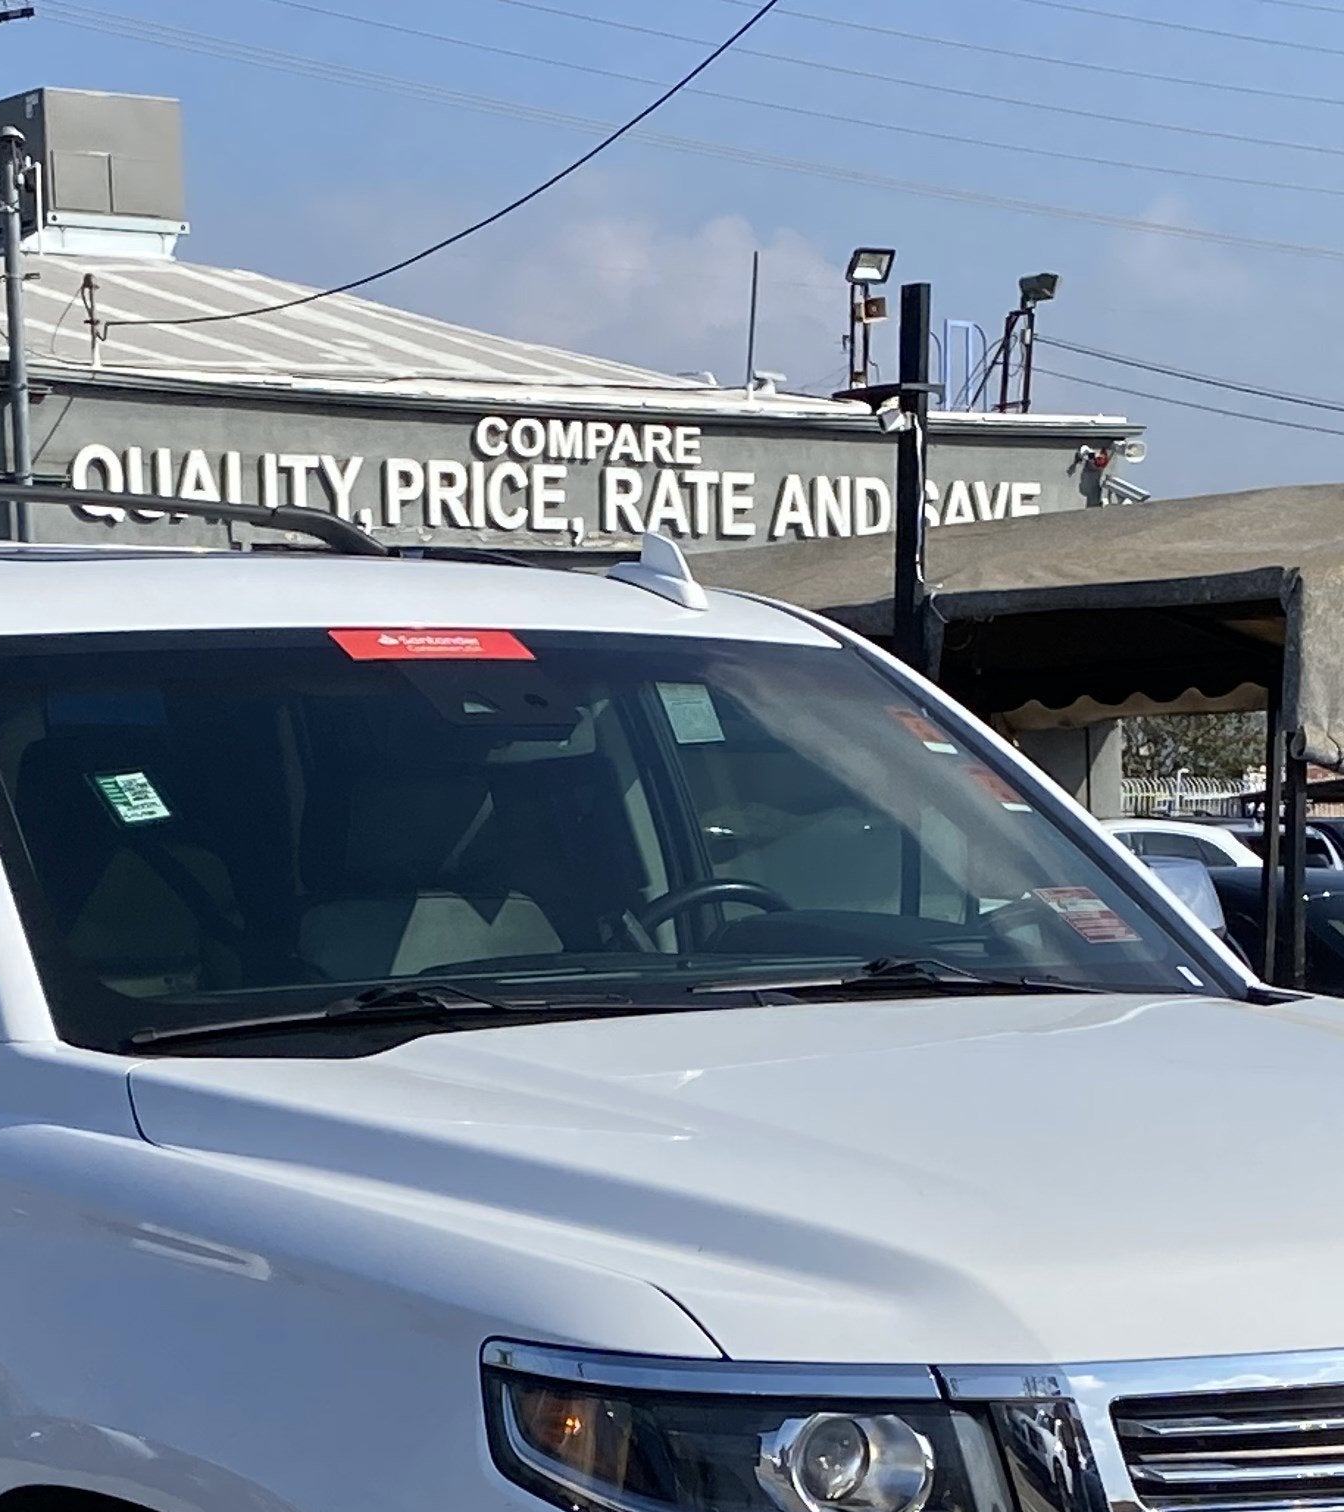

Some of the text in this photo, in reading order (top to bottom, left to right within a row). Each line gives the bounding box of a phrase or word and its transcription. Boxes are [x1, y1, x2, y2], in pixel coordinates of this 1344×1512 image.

[476, 416, 703, 464] COMPARE
[72, 443, 373, 536] QUALITY,
[385, 458, 586, 545] PRICE,
[604, 467, 757, 536] RATE
[773, 473, 892, 538] AND
